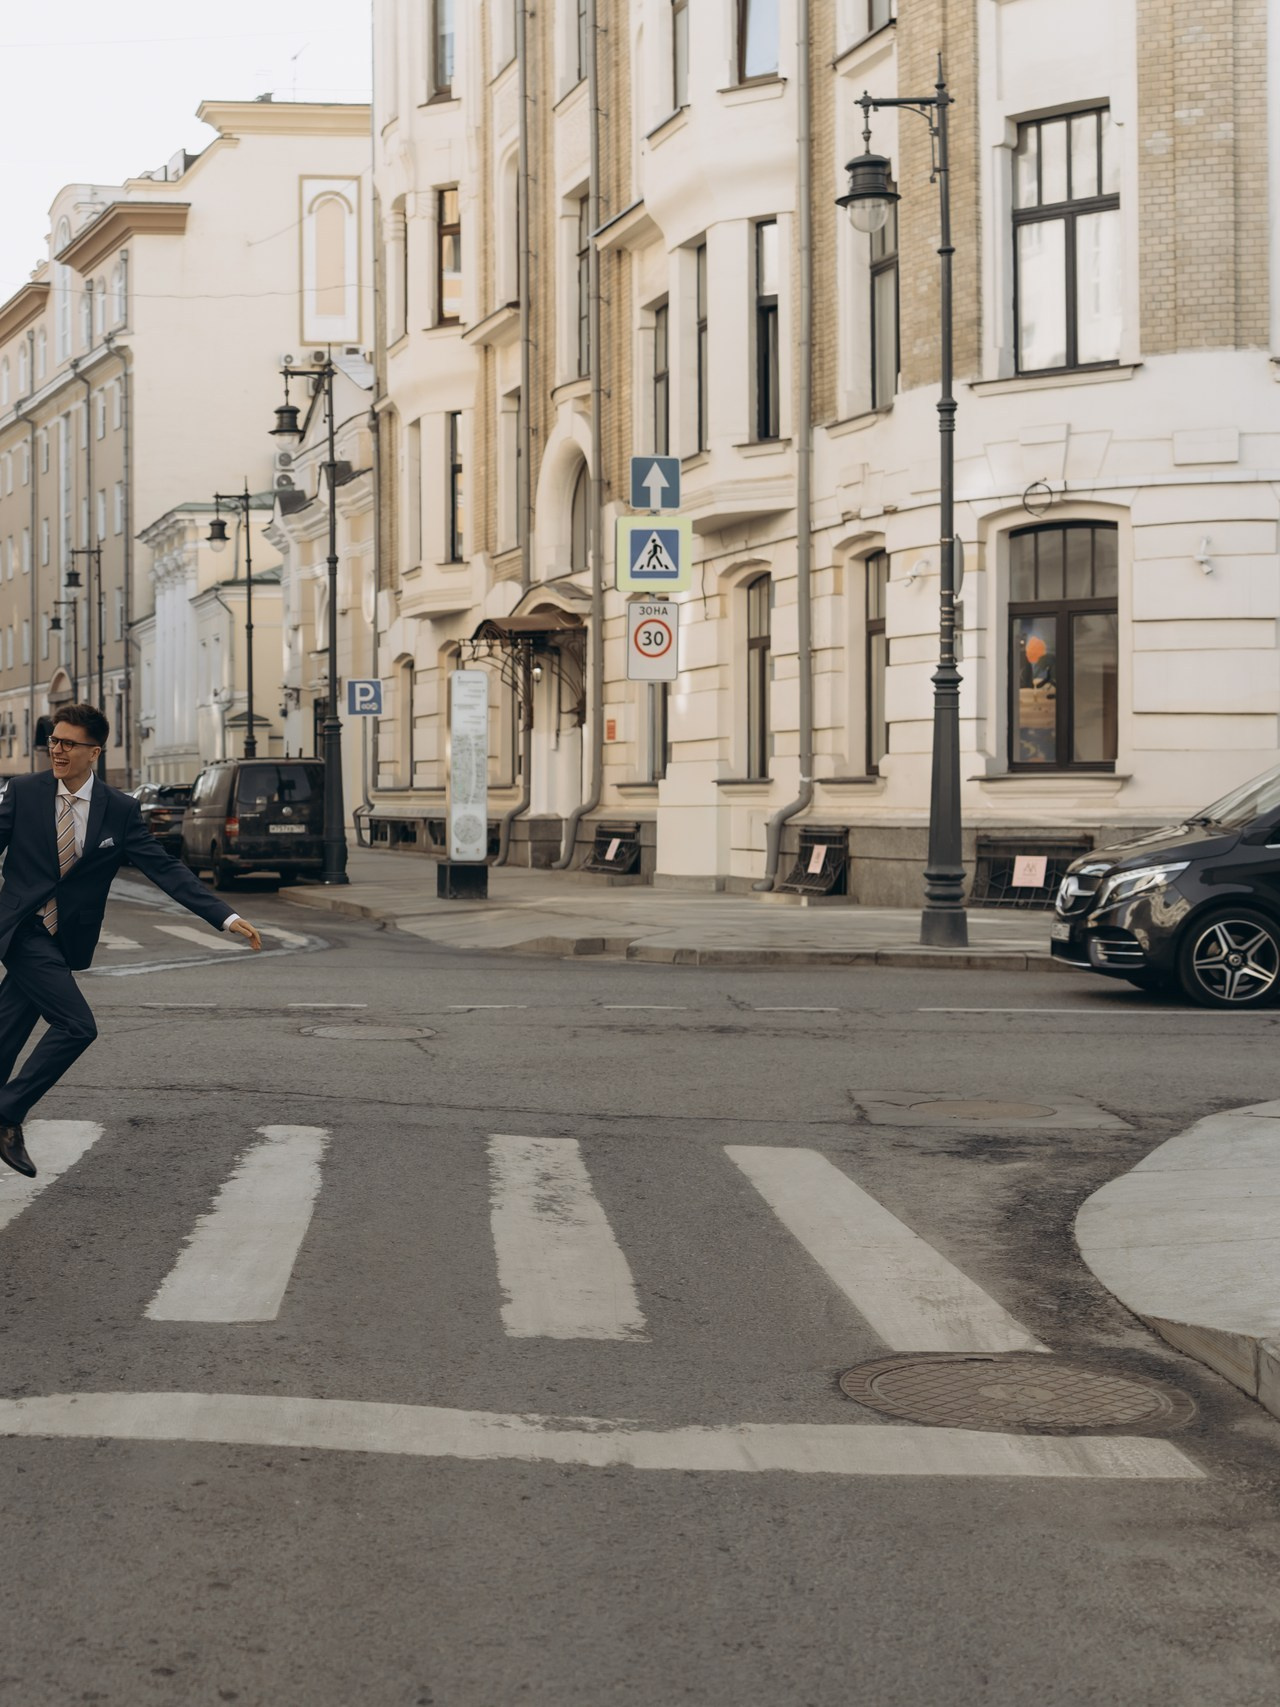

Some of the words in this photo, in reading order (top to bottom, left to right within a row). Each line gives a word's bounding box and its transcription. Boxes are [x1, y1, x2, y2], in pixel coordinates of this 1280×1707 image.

[639, 606, 668, 615] ЗОНА
[642, 630, 664, 646] 30
[354, 682, 375, 712] P
